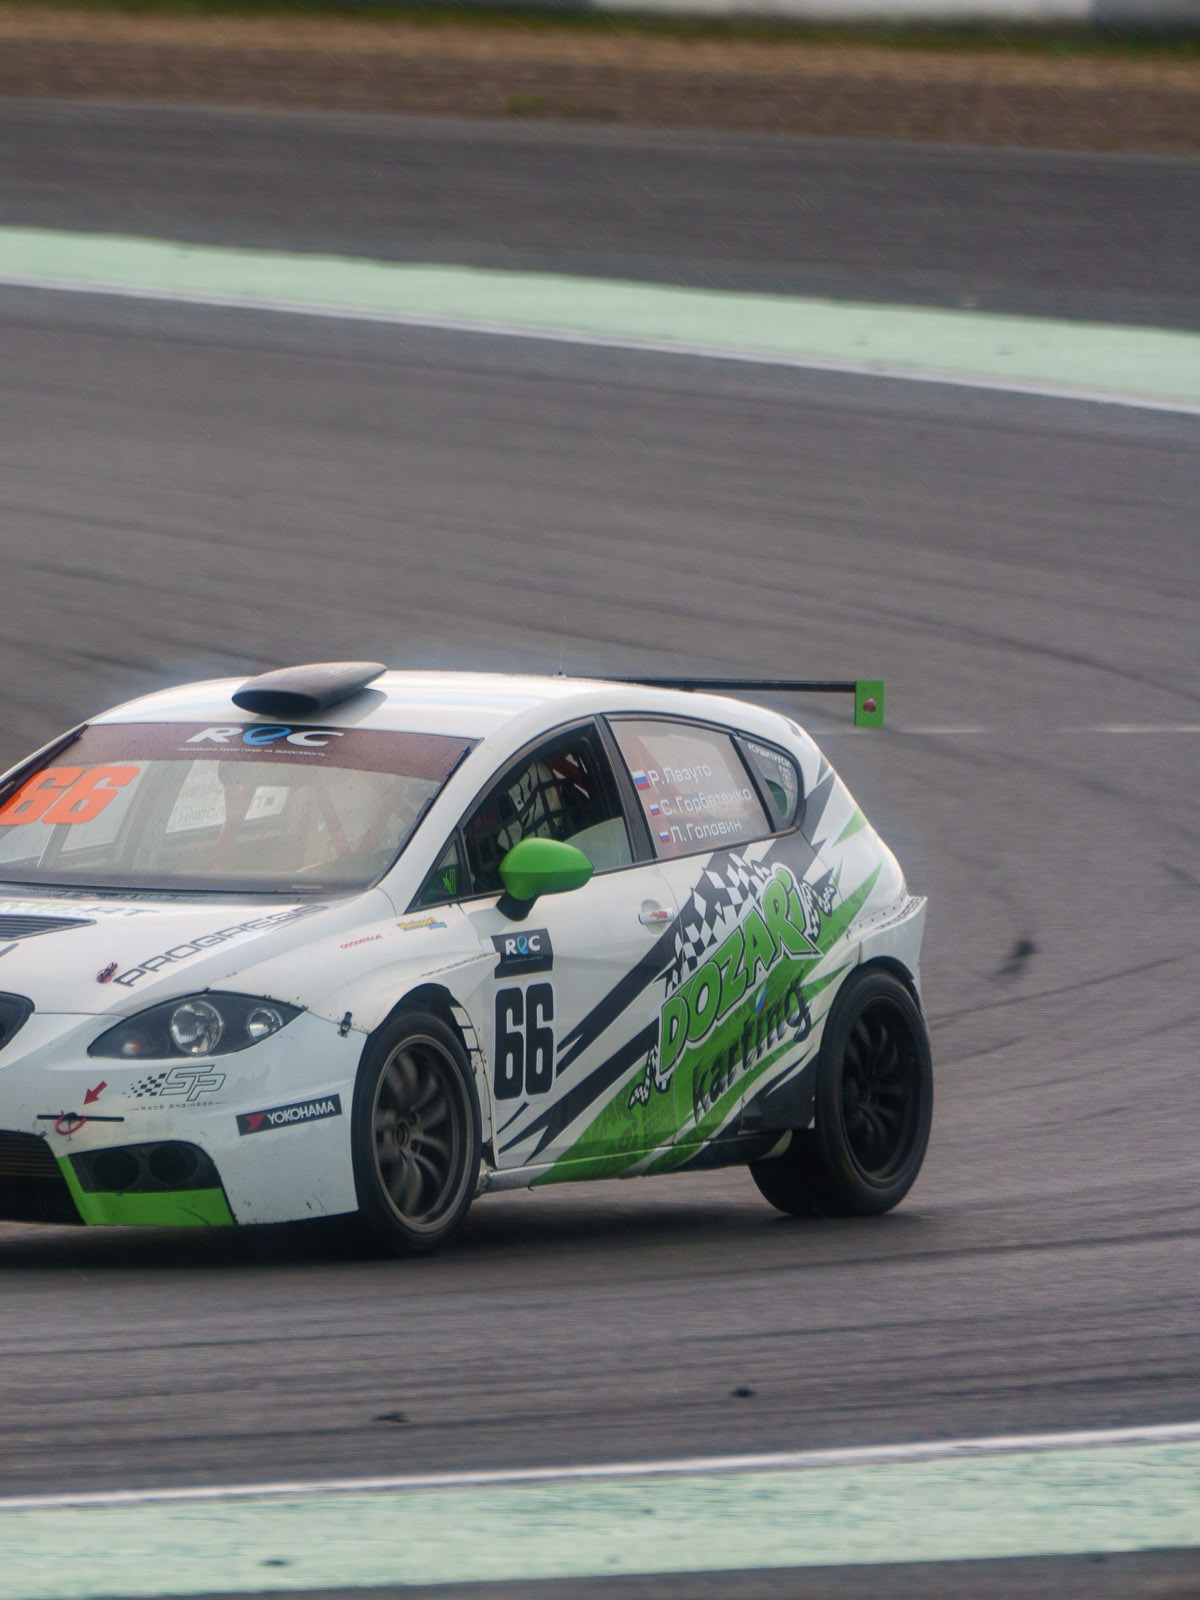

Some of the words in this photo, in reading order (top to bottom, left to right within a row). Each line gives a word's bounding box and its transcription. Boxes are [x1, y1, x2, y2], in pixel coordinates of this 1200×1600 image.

[113, 904, 329, 988] PROGRESS
[494, 982, 554, 1101] 66
[267, 1101, 336, 1125] YOKOHAMA
